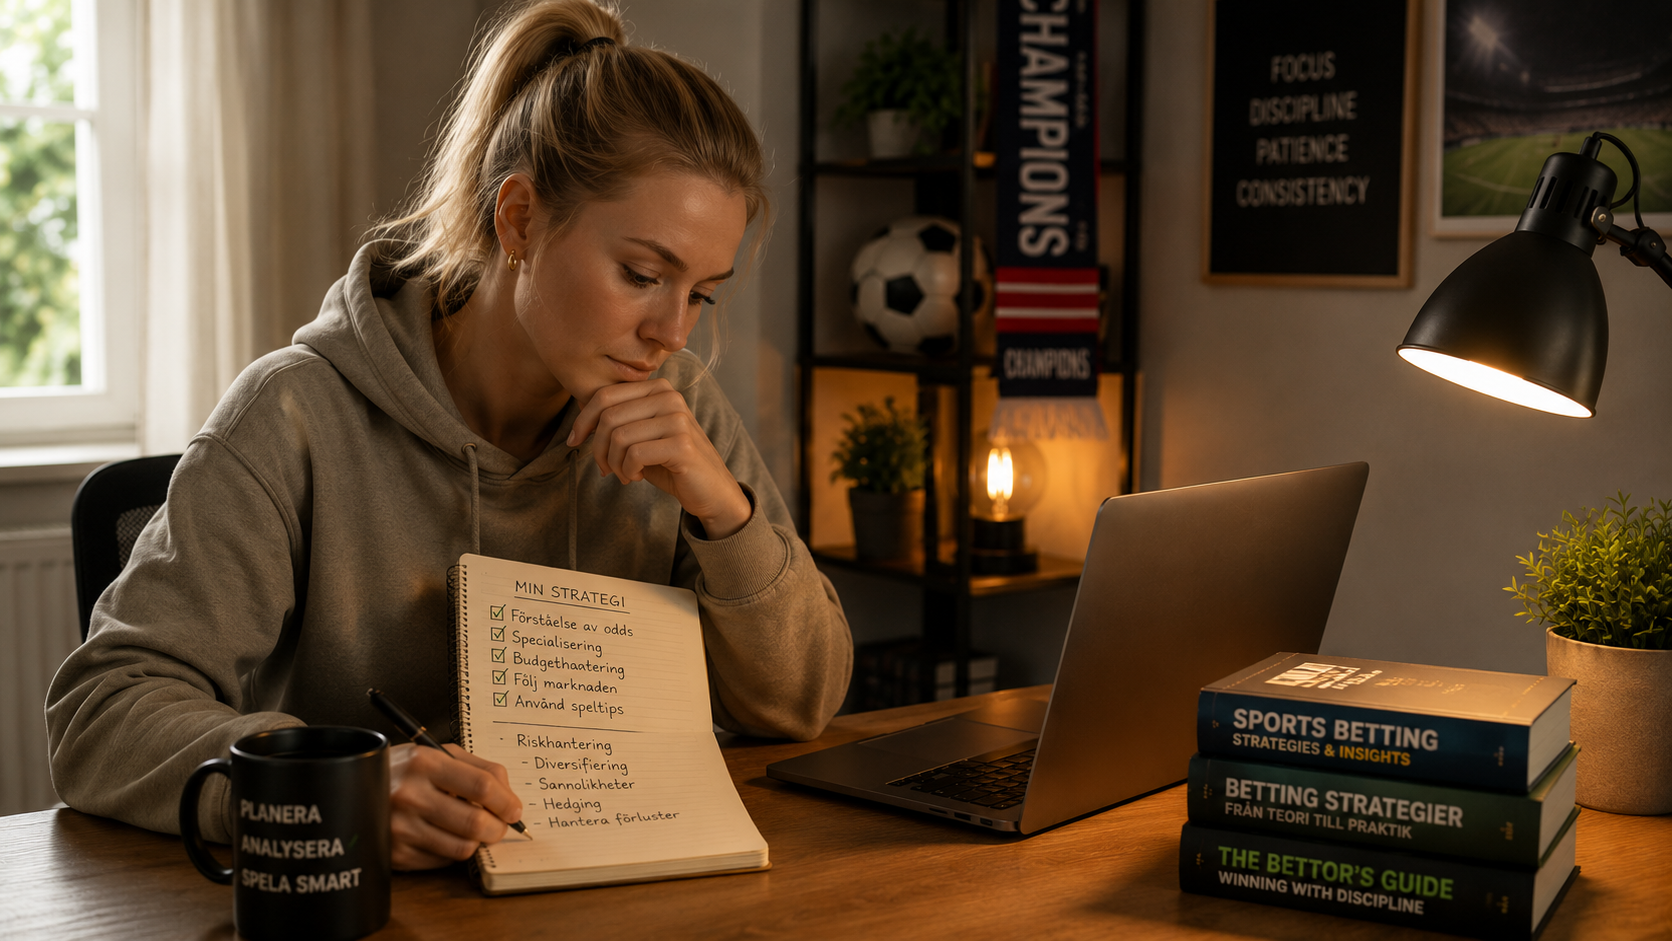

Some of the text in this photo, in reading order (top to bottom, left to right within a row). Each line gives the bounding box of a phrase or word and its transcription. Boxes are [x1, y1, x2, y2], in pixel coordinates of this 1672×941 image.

[1271, 51, 1336, 83] FOCUS
[1249, 90, 1358, 126] DISCIPLINE
[1256, 133, 1349, 165] PATIENCE
[1236, 175, 1370, 207] CONSISTENCY
[515, 580, 625, 607] MIN STRATEGI
[511, 609, 633, 637] Förståelse av odds
[512, 631, 603, 657] Specialisering
[513, 652, 624, 680] Budgethaatering
[514, 673, 617, 694] Följ marknaden
[515, 696, 624, 719] Använd speltips
[1233, 709, 1438, 751] SPORTS BETTING
[517, 734, 612, 755] Riskhantering
[1233, 733, 1411, 766] STRATEGIES & INSIGHTS
[535, 757, 628, 775] Diversifiering
[539, 778, 635, 790] Sannolikheter
[241, 799, 322, 823] PLANERA
[543, 798, 601, 812] Hedging
[1225, 778, 1318, 808] BETTING
[1325, 790, 1463, 827] STRATEGIER
[549, 810, 680, 828] Hantera förluster
[1225, 801, 1412, 839] FRÅN TEORI TILL PRAKTIK
[241, 835, 344, 858] ANALYSERA
[242, 868, 362, 893] SPELA SMART
[1219, 846, 1454, 899] THE BETTOR’S GUIDE
[1218, 871, 1424, 914] WINNING WITH DISCIPLINE
